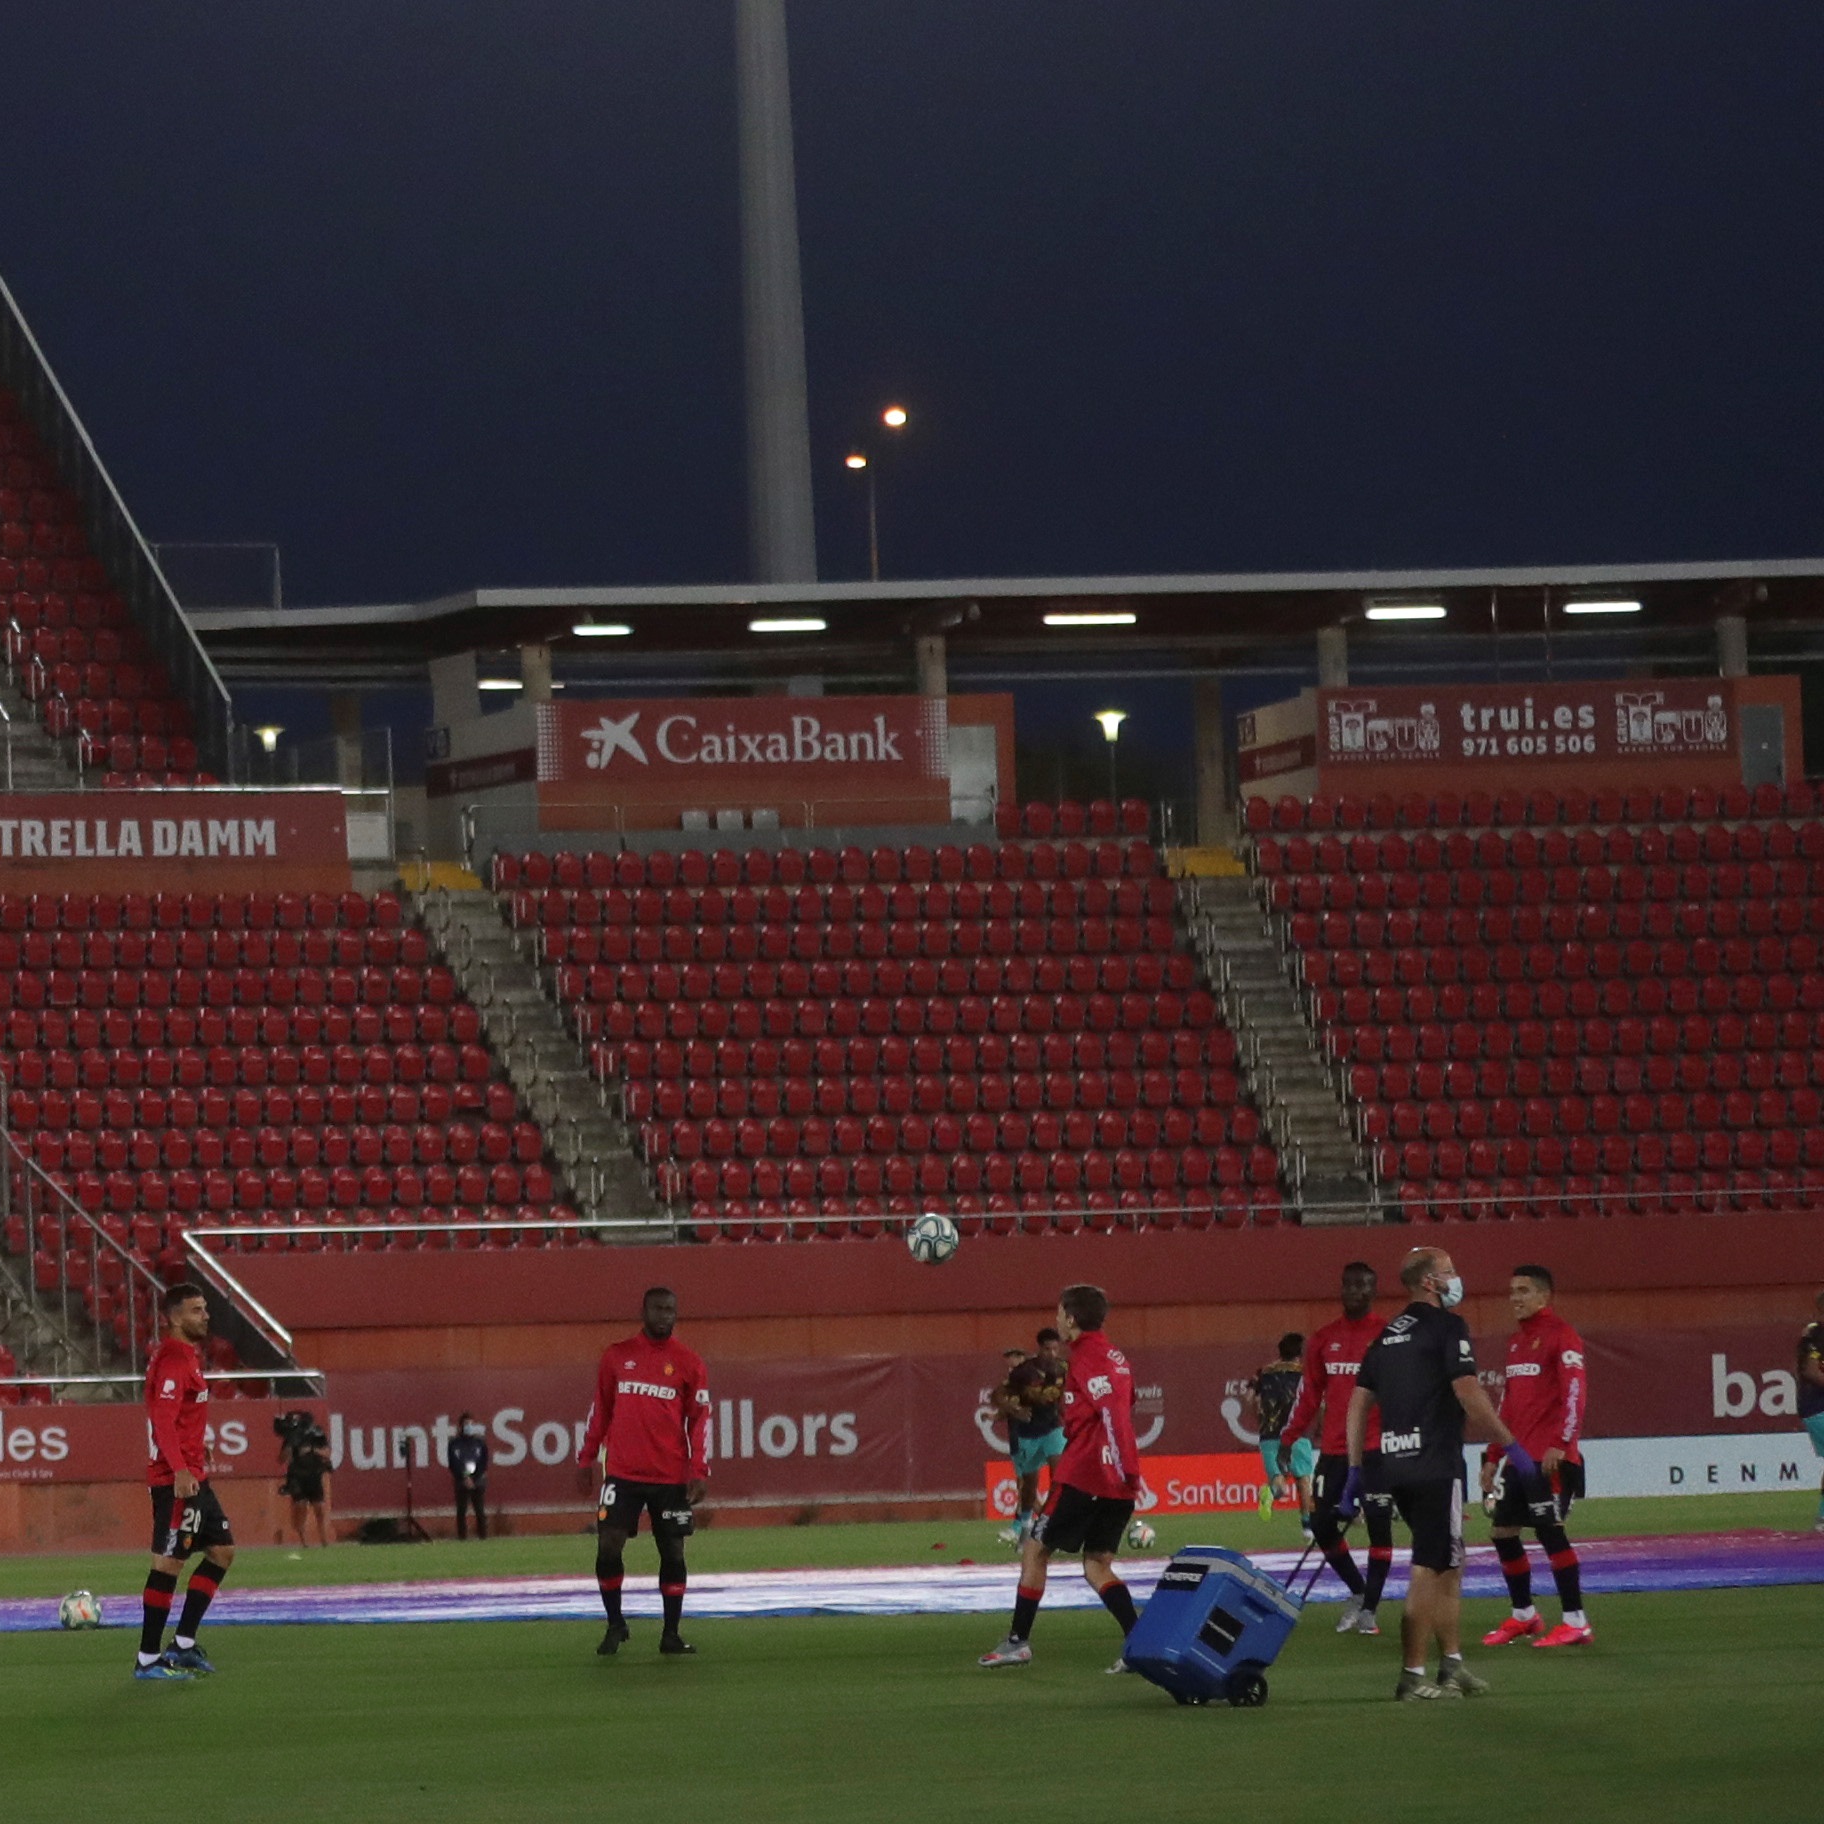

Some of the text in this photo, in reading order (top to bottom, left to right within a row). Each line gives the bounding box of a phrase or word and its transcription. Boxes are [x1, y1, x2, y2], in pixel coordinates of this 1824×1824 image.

[1460, 697, 1596, 732] trui.es
[655, 714, 904, 765] CaixaBank
[1462, 737, 1499, 756] 971
[1506, 736, 1548, 755] 605
[1555, 733, 1597, 754] 506
[153, 819, 276, 857] DAMM
[618, 1380, 677, 1400] BETFRED
[1167, 1479, 1297, 1505] Santan
[180, 1507, 202, 1534] 20
